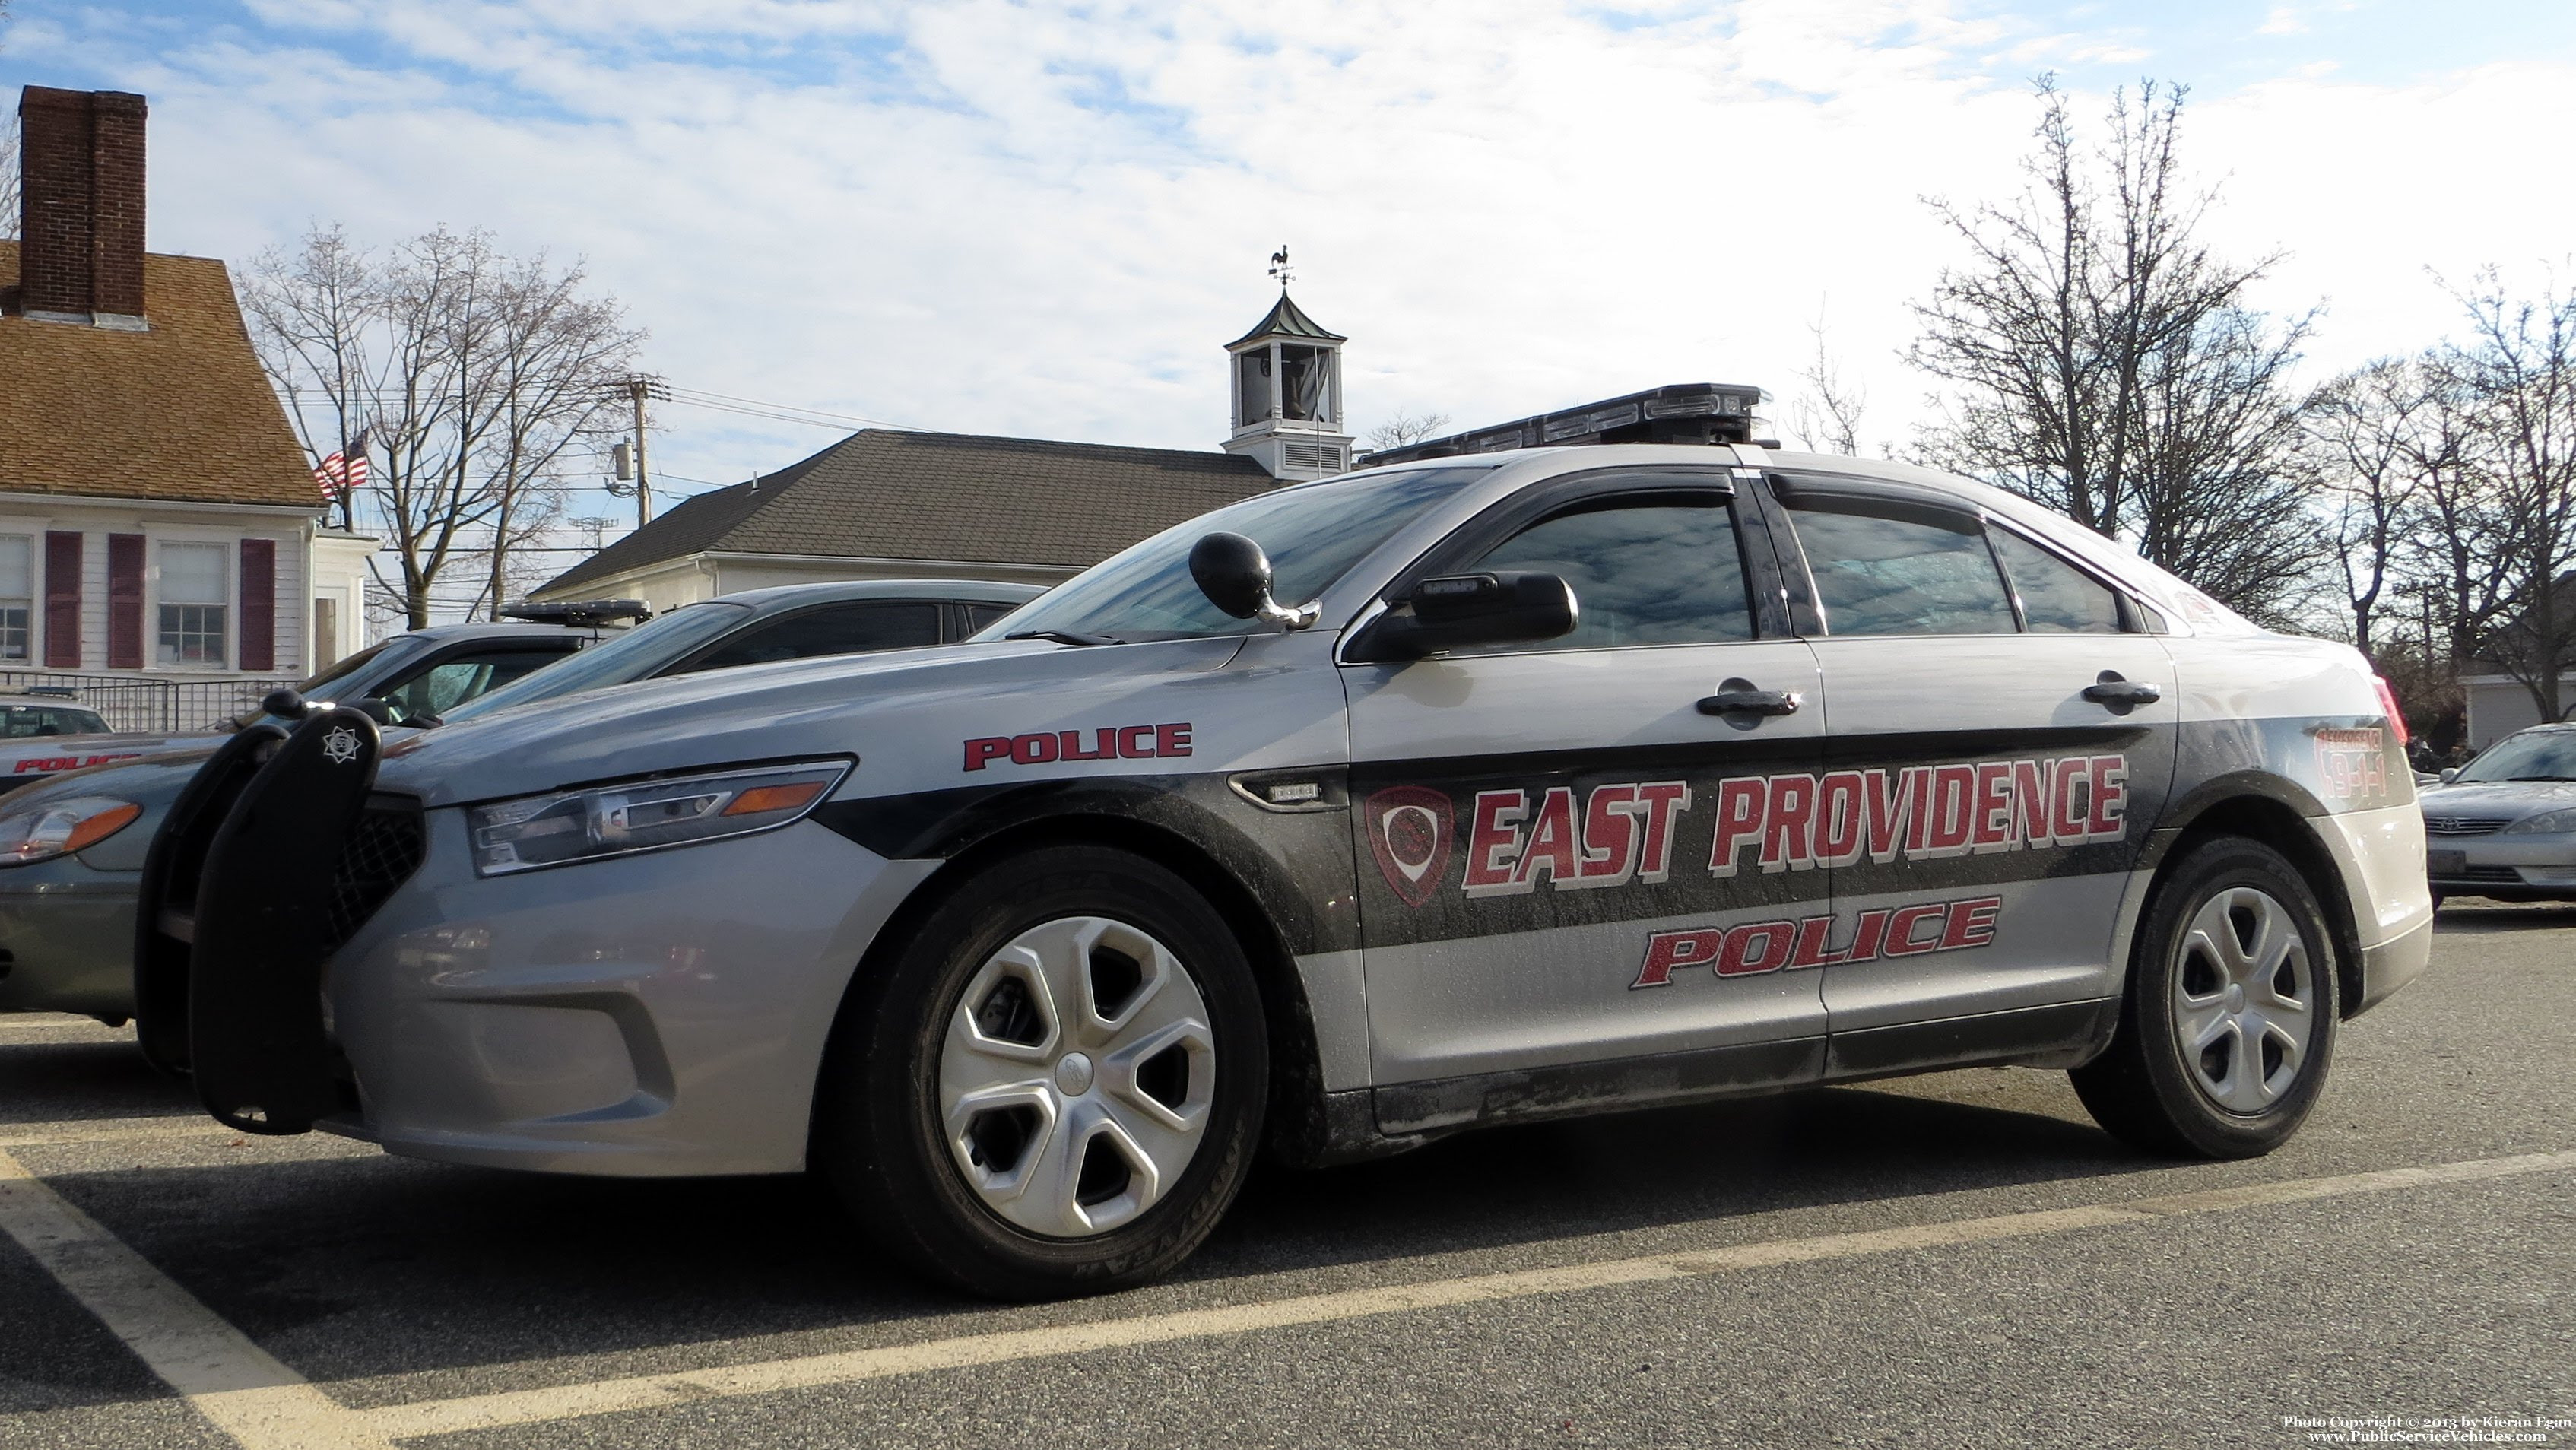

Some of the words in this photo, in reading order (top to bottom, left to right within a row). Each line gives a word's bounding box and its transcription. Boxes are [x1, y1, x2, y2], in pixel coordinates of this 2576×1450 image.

[963, 722, 1193, 772] POLICE
[2330, 753, 2386, 798] 9-1-1
[1461, 780, 1692, 898] EAST
[1708, 754, 2129, 878] PROVIDENCE
[1629, 896, 2002, 991] POLICE
